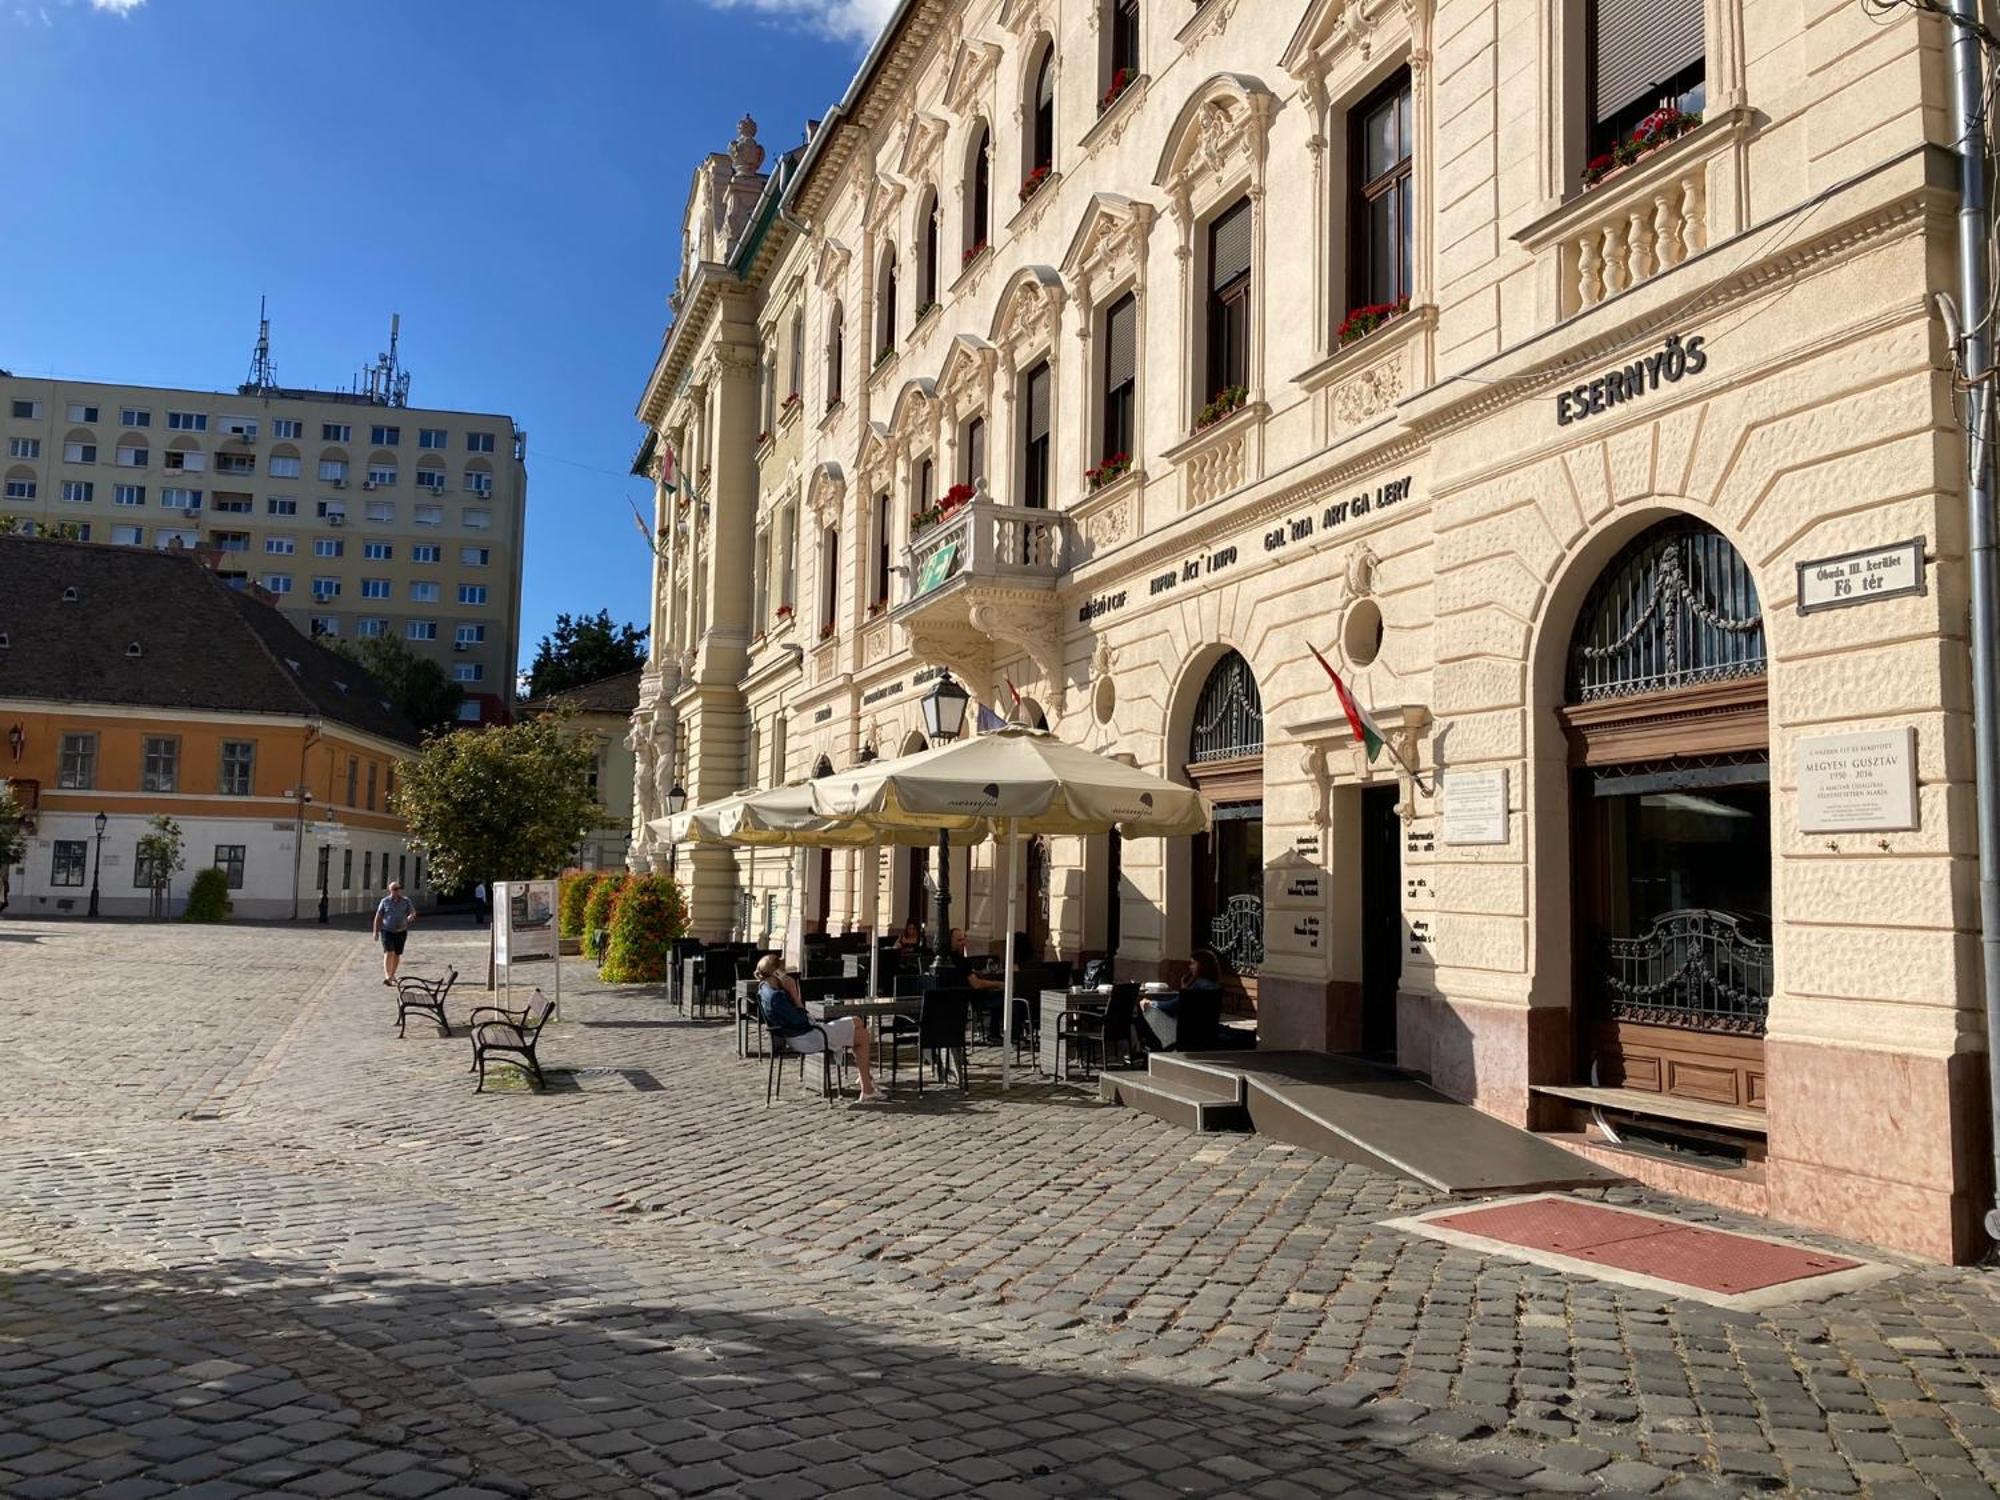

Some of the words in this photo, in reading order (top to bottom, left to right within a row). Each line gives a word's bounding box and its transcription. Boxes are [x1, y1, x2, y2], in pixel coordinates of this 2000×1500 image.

[1264, 517, 1313, 551] GALRIA
[1322, 501, 1349, 530] ART
[1350, 476, 1412, 518] GALERY
[1150, 554, 1205, 596] INFORÁCI
[1863, 573, 1884, 591] tér
